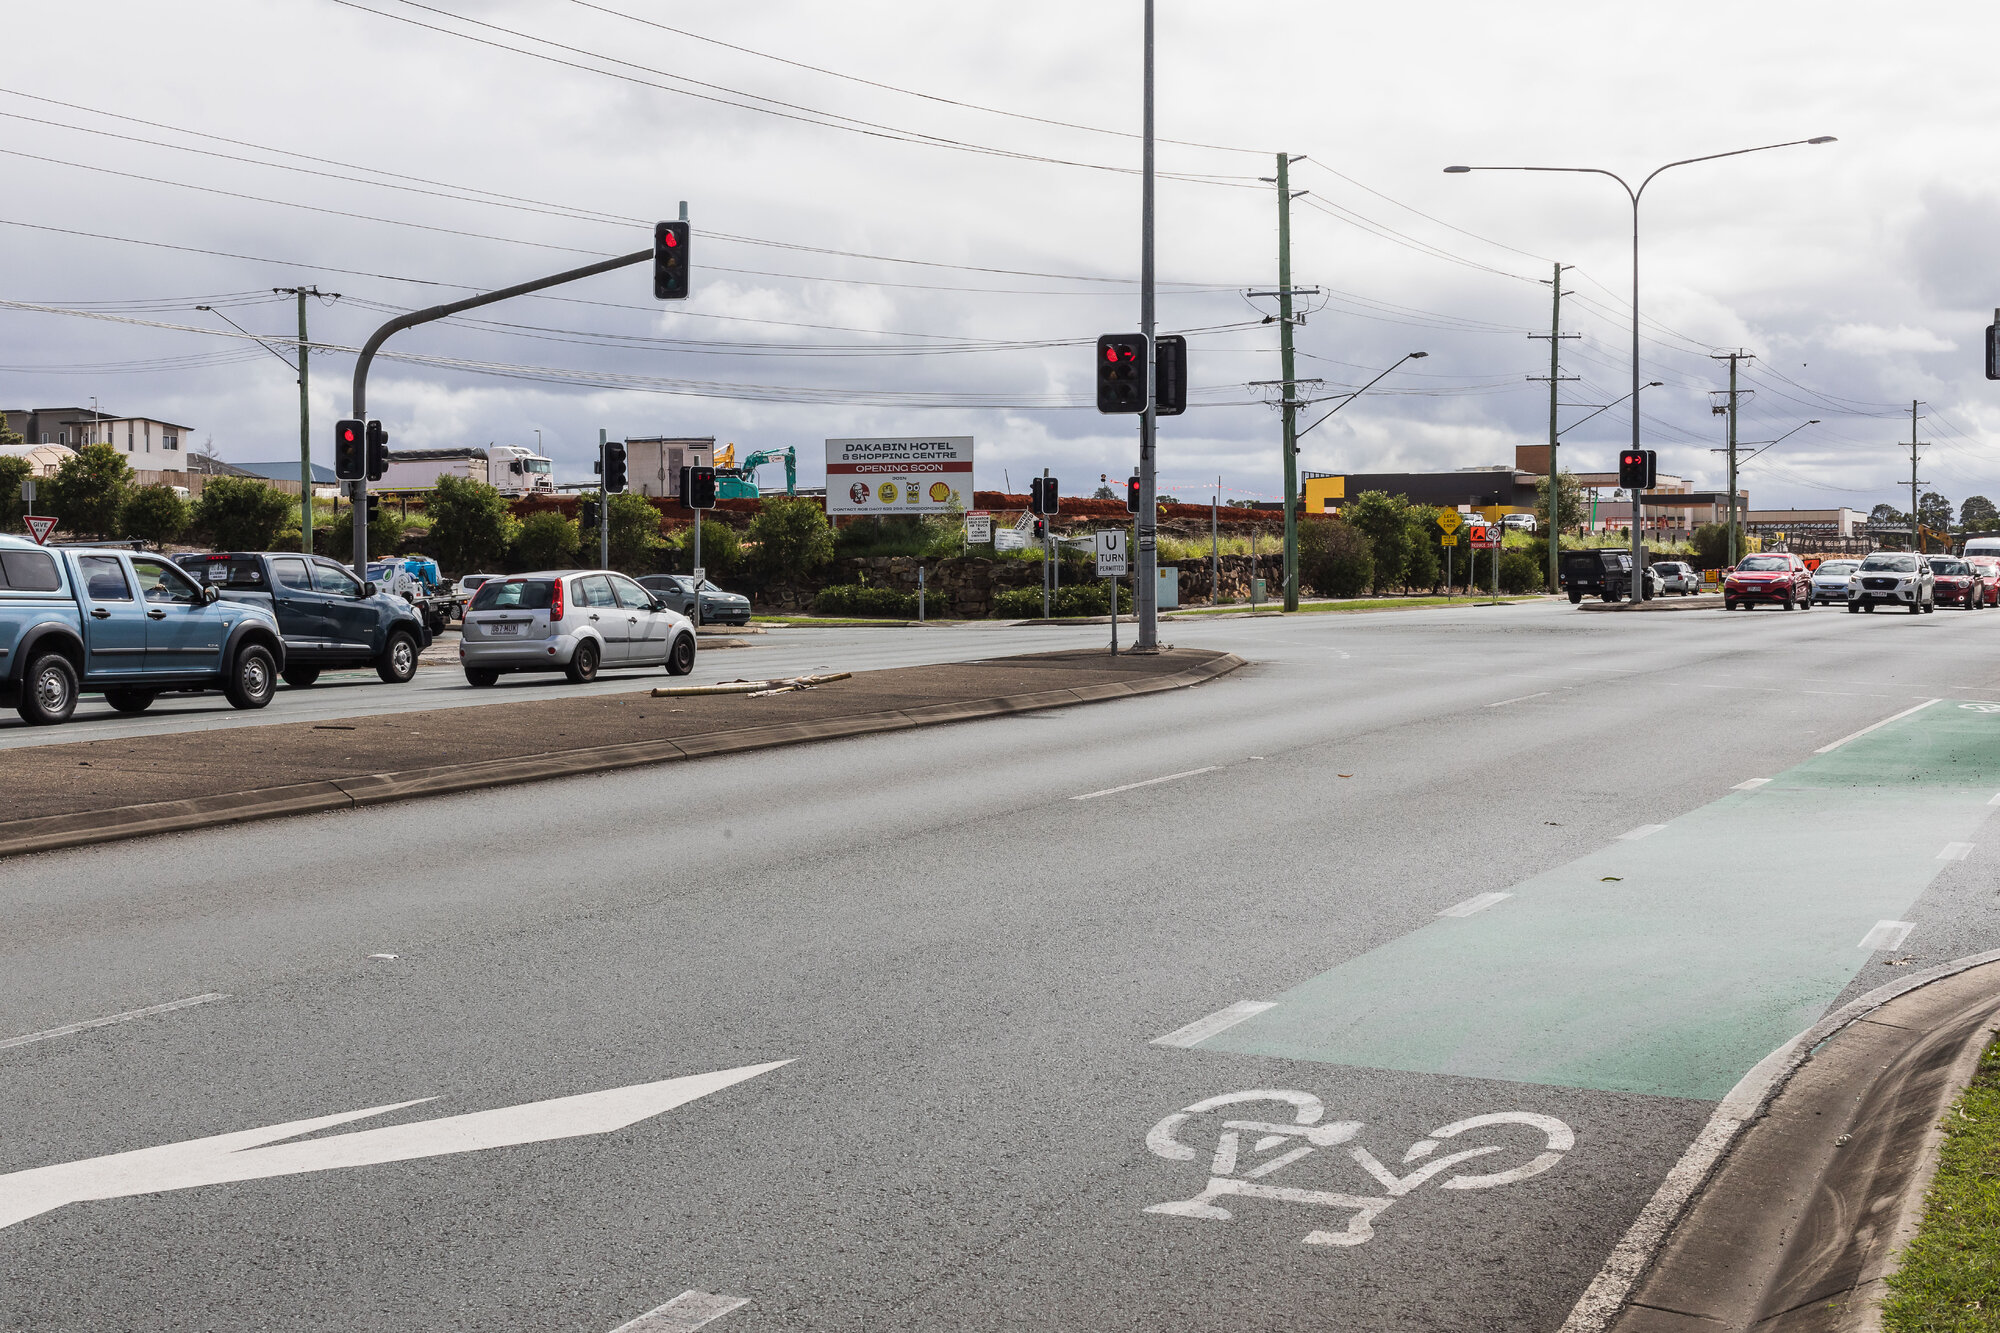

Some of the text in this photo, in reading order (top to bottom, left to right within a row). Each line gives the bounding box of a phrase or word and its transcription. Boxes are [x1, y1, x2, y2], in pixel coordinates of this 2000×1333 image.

[845, 442, 954, 452] DAKABIN HOTEL
[851, 452, 911, 460] SHOPPING
[912, 451, 958, 459] CENTRE
[855, 463, 944, 473] OPENING SOON
[1106, 535, 1117, 550] U
[1100, 553, 1124, 562] TURN
